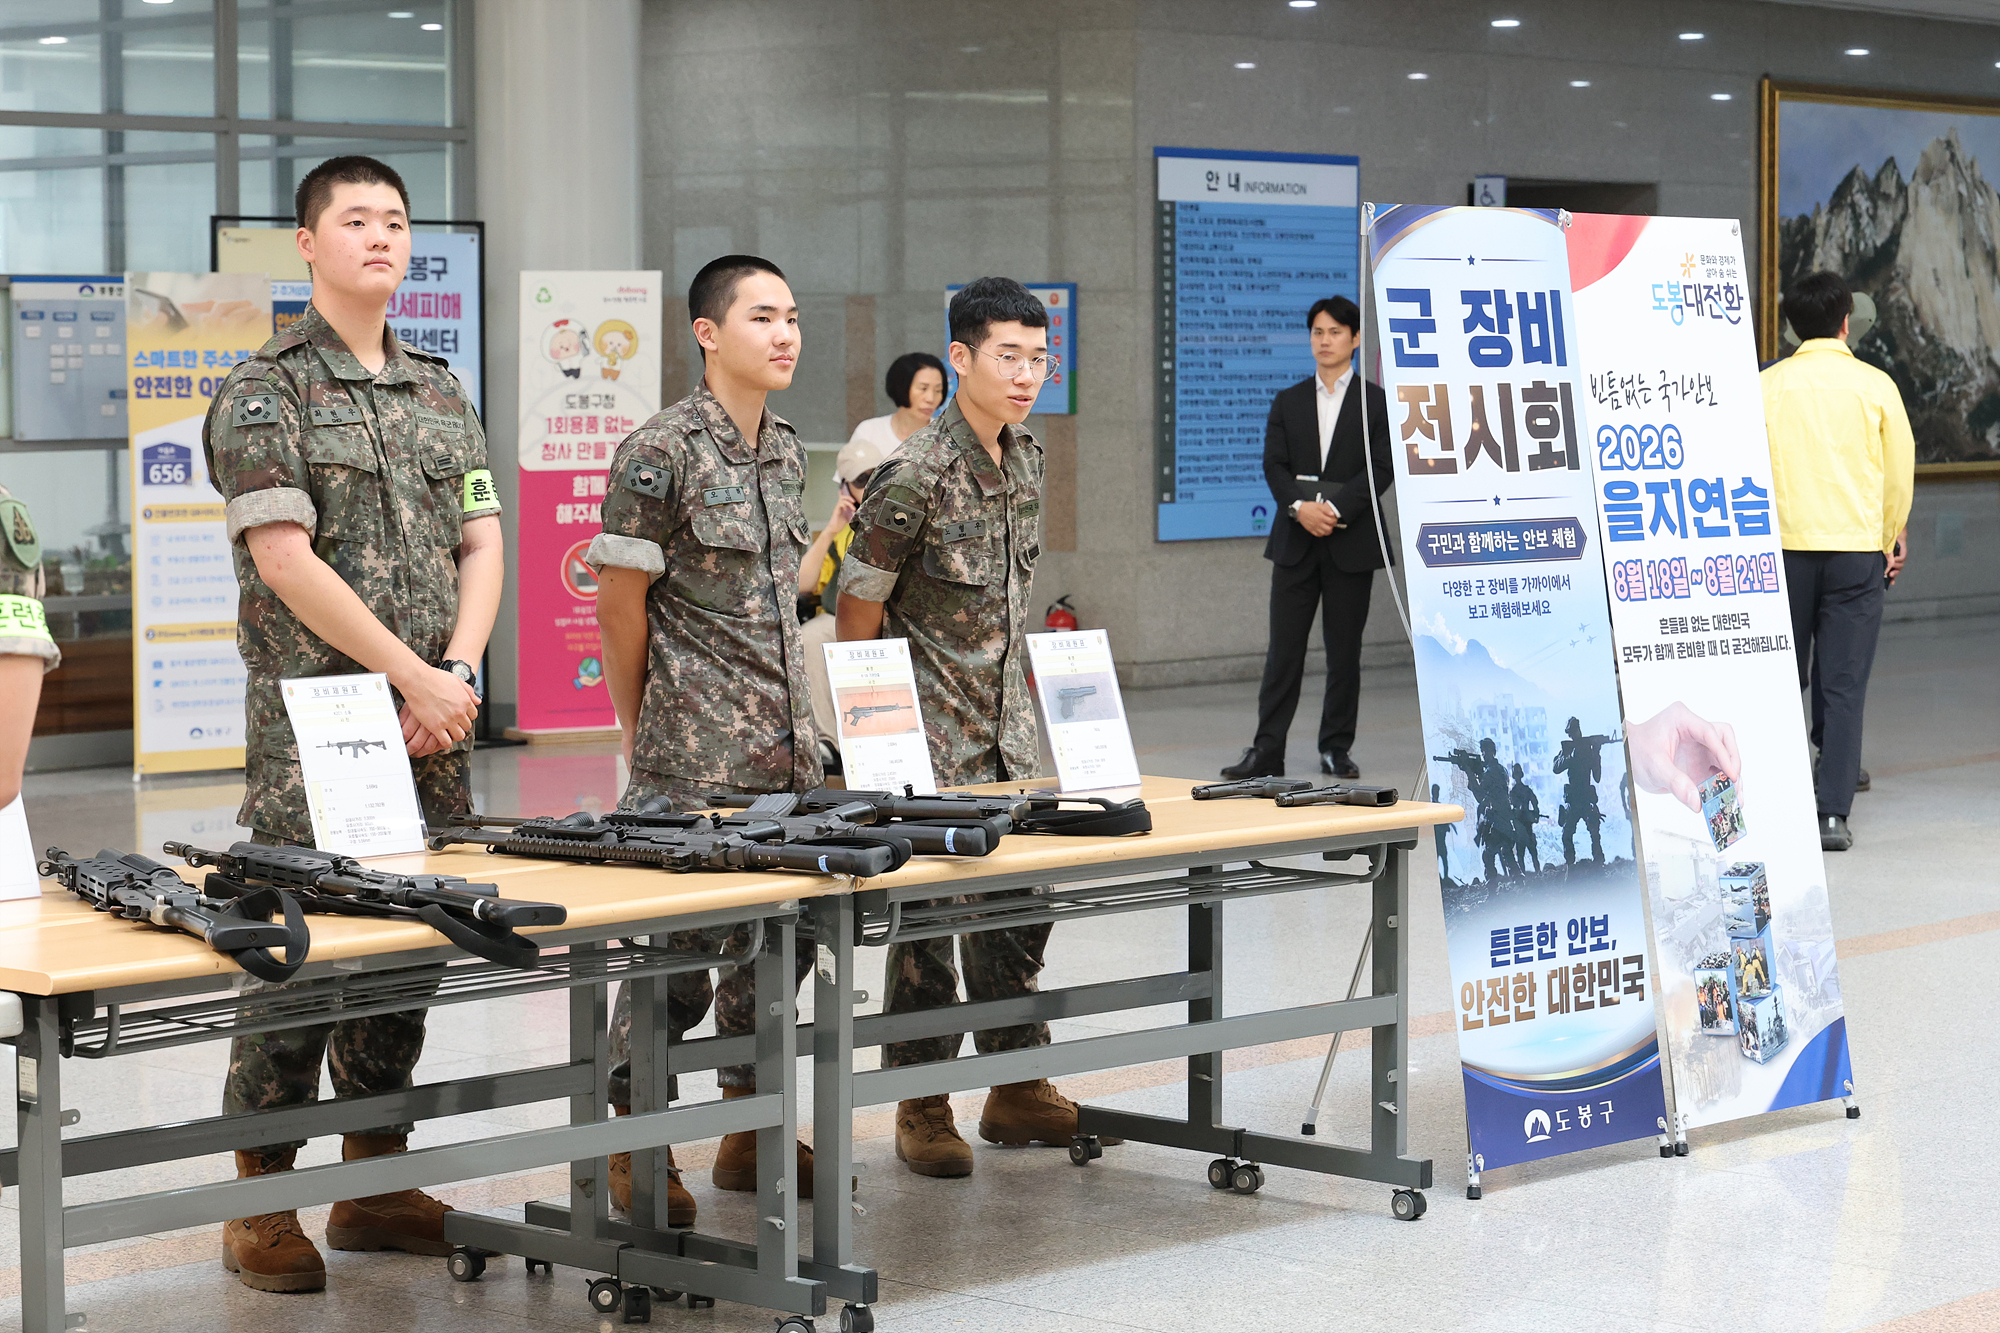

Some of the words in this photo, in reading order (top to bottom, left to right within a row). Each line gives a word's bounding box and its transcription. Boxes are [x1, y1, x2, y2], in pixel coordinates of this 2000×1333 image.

[1244, 182, 1307, 195] INFORMATION
[403, 256, 448, 281] 봉구
[1700, 254, 1717, 265] 문화와
[1719, 254, 1736, 266] 경제가
[1706, 268, 1717, 278] 살아
[1726, 268, 1737, 278] 쉬는
[1386, 287, 1439, 368] 군
[1460, 288, 1568, 369] 장비
[134, 350, 198, 368] 스마트한
[134, 376, 193, 399] 안전한
[1590, 370, 1652, 411] 빈틈없는
[1658, 369, 1718, 413] 국가안보
[565, 394, 615, 409] 도봉구청
[545, 416, 599, 434] 1회용품
[605, 414, 634, 434] 없는
[1396, 380, 1581, 475] 전시회
[542, 442, 572, 461] 청사
[1597, 423, 1685, 471] 2026
[149, 463, 186, 484] 656
[1603, 477, 1771, 542] 을지연습
[1427, 532, 1465, 556] 구민과
[1468, 530, 1520, 554] 함께하는
[1522, 529, 1549, 550] 안보
[1551, 527, 1577, 549] 체험
[1442, 580, 1472, 598] 다양한
[1475, 579, 1485, 596] 군
[1488, 577, 1518, 595] 장비를
[1521, 574, 1571, 593] 가까이에서
[1613, 558, 1647, 602] 8월
[1736, 552, 1780, 593] 21일
[1468, 604, 1489, 619] 보고
[1491, 600, 1552, 619] 체험해보세요
[1659, 616, 1689, 635] 흔들림
[1690, 615, 1710, 633] 없는
[1712, 612, 1751, 631] 대한민국
[1622, 644, 1653, 664] 모두가
[1654, 643, 1675, 661] 함께
[1676, 641, 1706, 659] 준비할
[1707, 640, 1719, 657] 때
[1720, 638, 1730, 655] 더
[1732, 634, 1792, 654] 굳건해집니다.
[1490, 921, 1558, 968] 튼튼한
[1567, 914, 1617, 956] 안보,
[1460, 971, 1537, 1031] 안전한
[1547, 954, 1645, 1015] 대한민국
[1555, 1100, 1615, 1133] 도봉구
